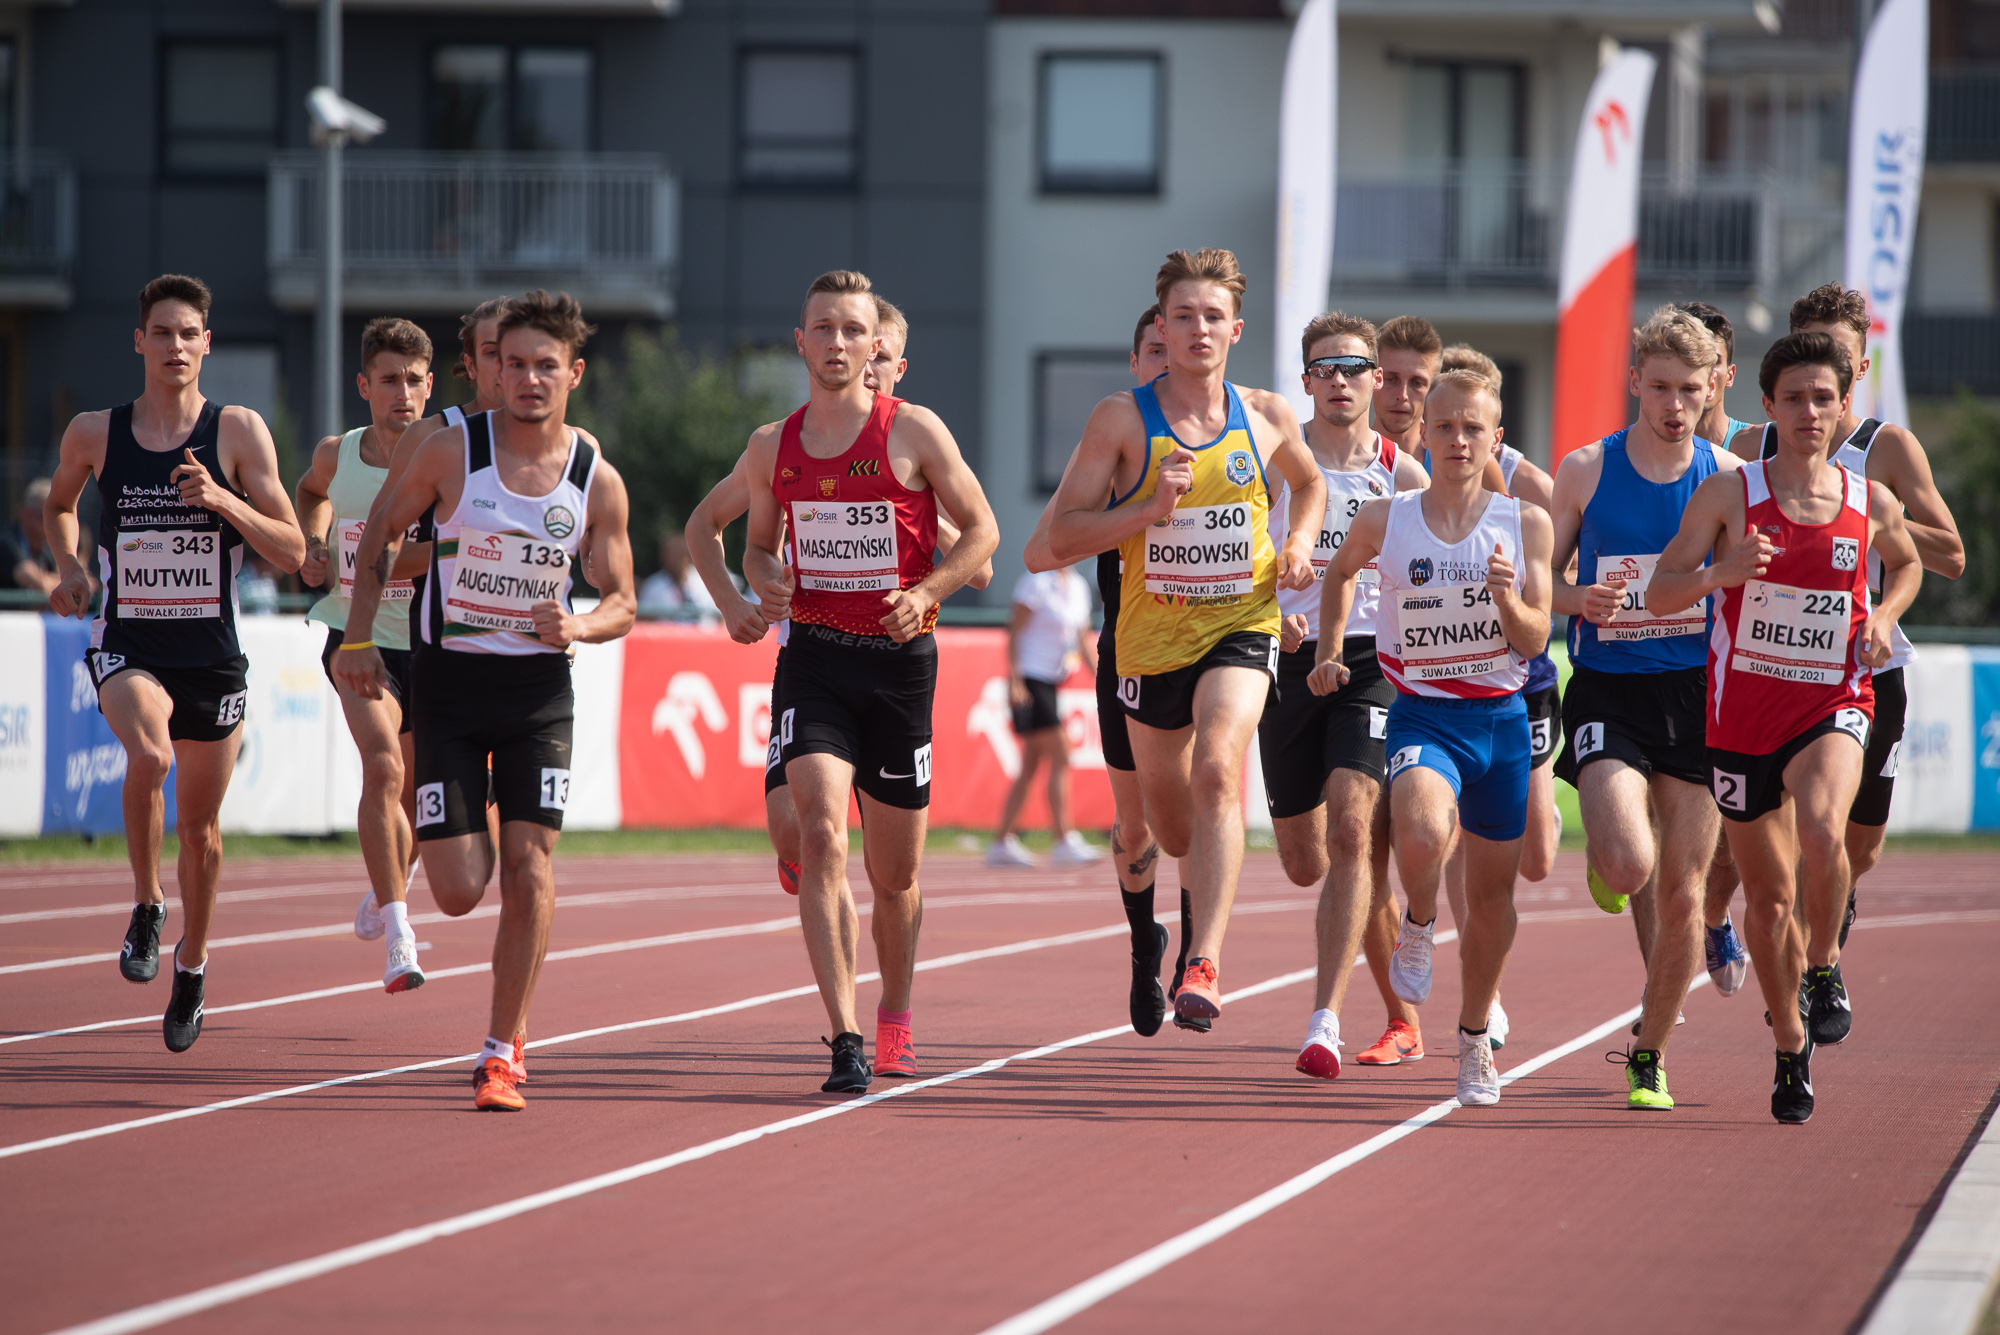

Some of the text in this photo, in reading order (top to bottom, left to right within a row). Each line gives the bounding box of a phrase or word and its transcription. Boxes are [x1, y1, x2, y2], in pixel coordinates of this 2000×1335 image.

[472, 498, 496, 510] esa
[548, 511, 570, 524] RKS
[846, 506, 889, 526] 353
[1172, 518, 1195, 526] OSIR
[1204, 508, 1245, 530] 360
[172, 536, 213, 554] 343
[469, 548, 500, 559] ORLEN
[800, 535, 892, 559] MASACZYŃSKI
[1150, 542, 1249, 564] BOROWSKI
[521, 544, 564, 568] 133
[125, 568, 212, 587] MUTWIL
[456, 567, 559, 600] AUGUSTYNIAK
[814, 579, 881, 589] SUWAŁKI 2021
[1608, 571, 1637, 580] ORLEN
[392, 589, 412, 598] 2021
[1163, 584, 1209, 594] SUWAŁKI
[1213, 583, 1236, 594] 2021
[1463, 586, 1491, 608] 54
[134, 607, 202, 617] SUWAŁKI 2021
[1803, 594, 1846, 616] 224
[463, 613, 511, 628] SUWAŁKI
[514, 620, 533, 630] 202
[808, 625, 903, 650] NIKE PRO
[1404, 619, 1502, 648] SZYNAKA
[1616, 626, 1688, 639] SUWAŁKI 2021
[1752, 620, 1834, 650] BIELSKI
[95, 653, 122, 674] 15
[1422, 662, 1493, 678] SUWAŁKI 2021
[1750, 662, 1824, 681] SUWAŁKI 2021
[221, 696, 243, 721] 15
[1413, 696, 1512, 710] NIKE PRO
[1845, 710, 1863, 737] 2
[1578, 726, 1596, 752] 4
[918, 751, 931, 779] 11
[543, 776, 569, 804] 13
[1719, 776, 1737, 807] 2
[418, 791, 442, 820] 13
